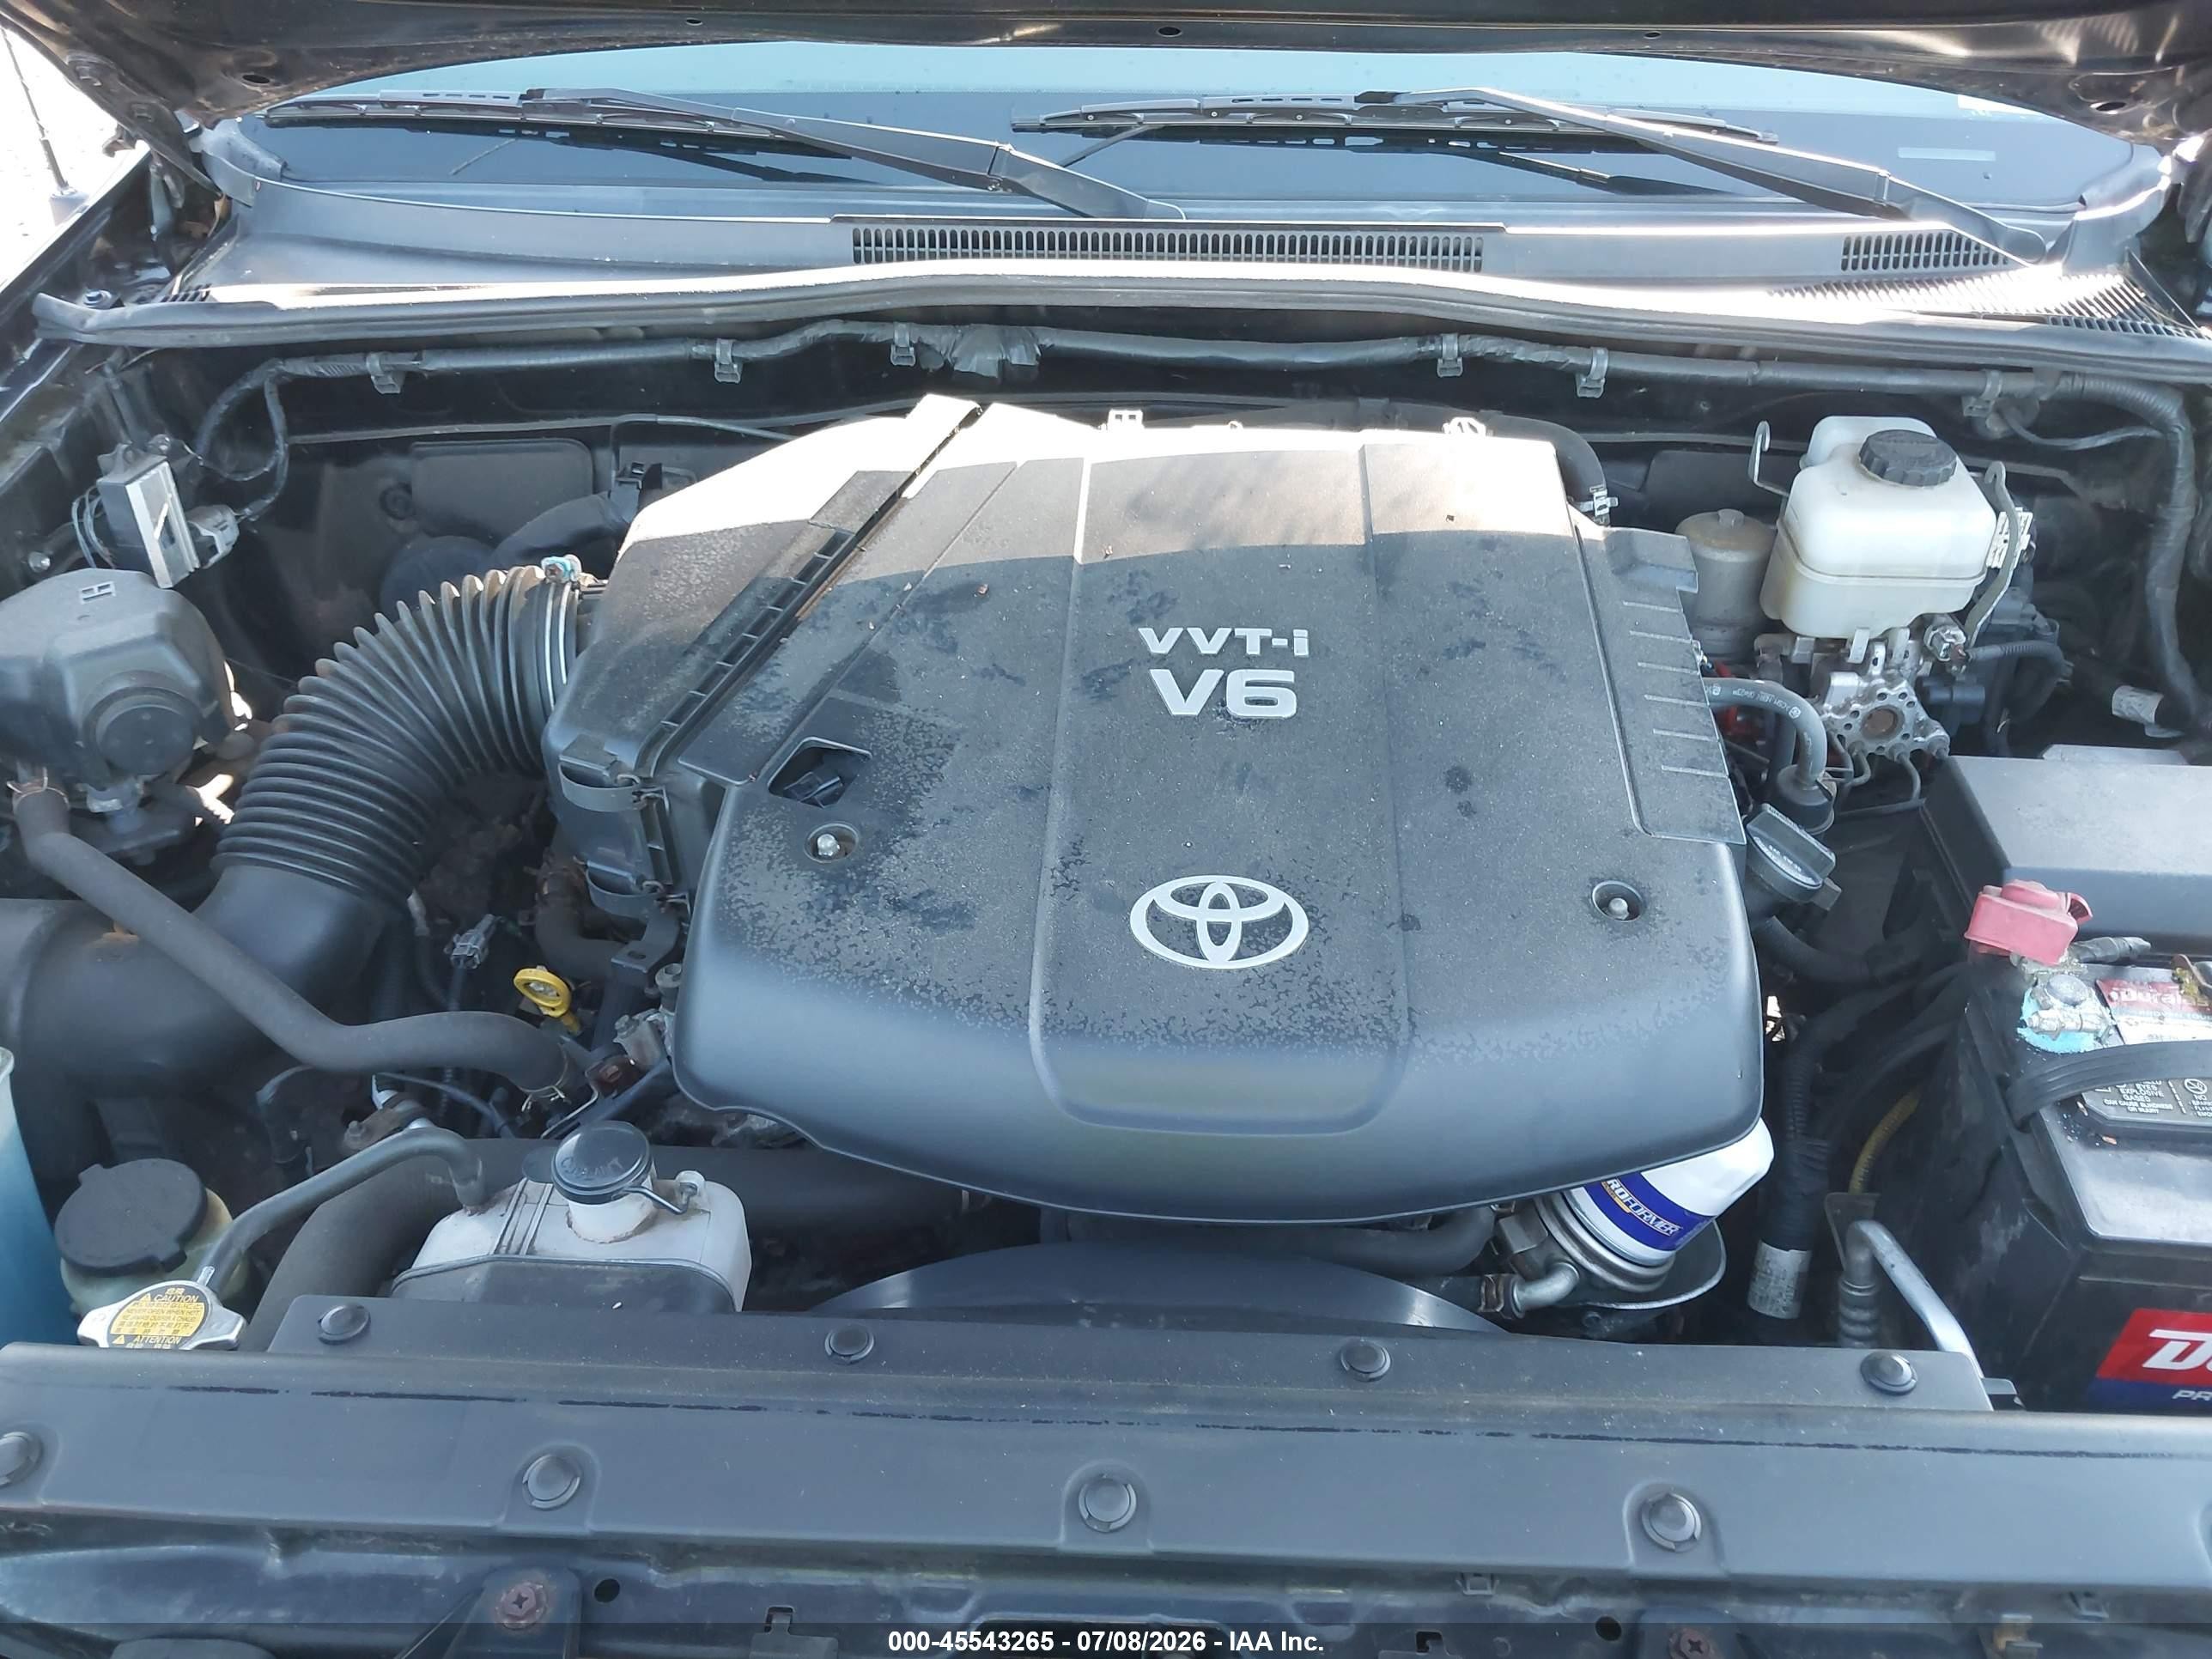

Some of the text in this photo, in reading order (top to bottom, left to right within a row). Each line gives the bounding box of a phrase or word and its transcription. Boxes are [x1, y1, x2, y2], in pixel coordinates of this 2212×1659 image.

[1138, 628, 1310, 657] VVT-i
[1149, 668, 1297, 720] V6
[2119, 1087, 2165, 1097] EXPLOSIVE
[1607, 1178, 1680, 1235] ROFORMER
[153, 1294, 199, 1304] CAUTION
[131, 1334, 182, 1345] ATTENTION
[2142, 1328, 2212, 1371] D
[2172, 1389, 2212, 1401] PR
